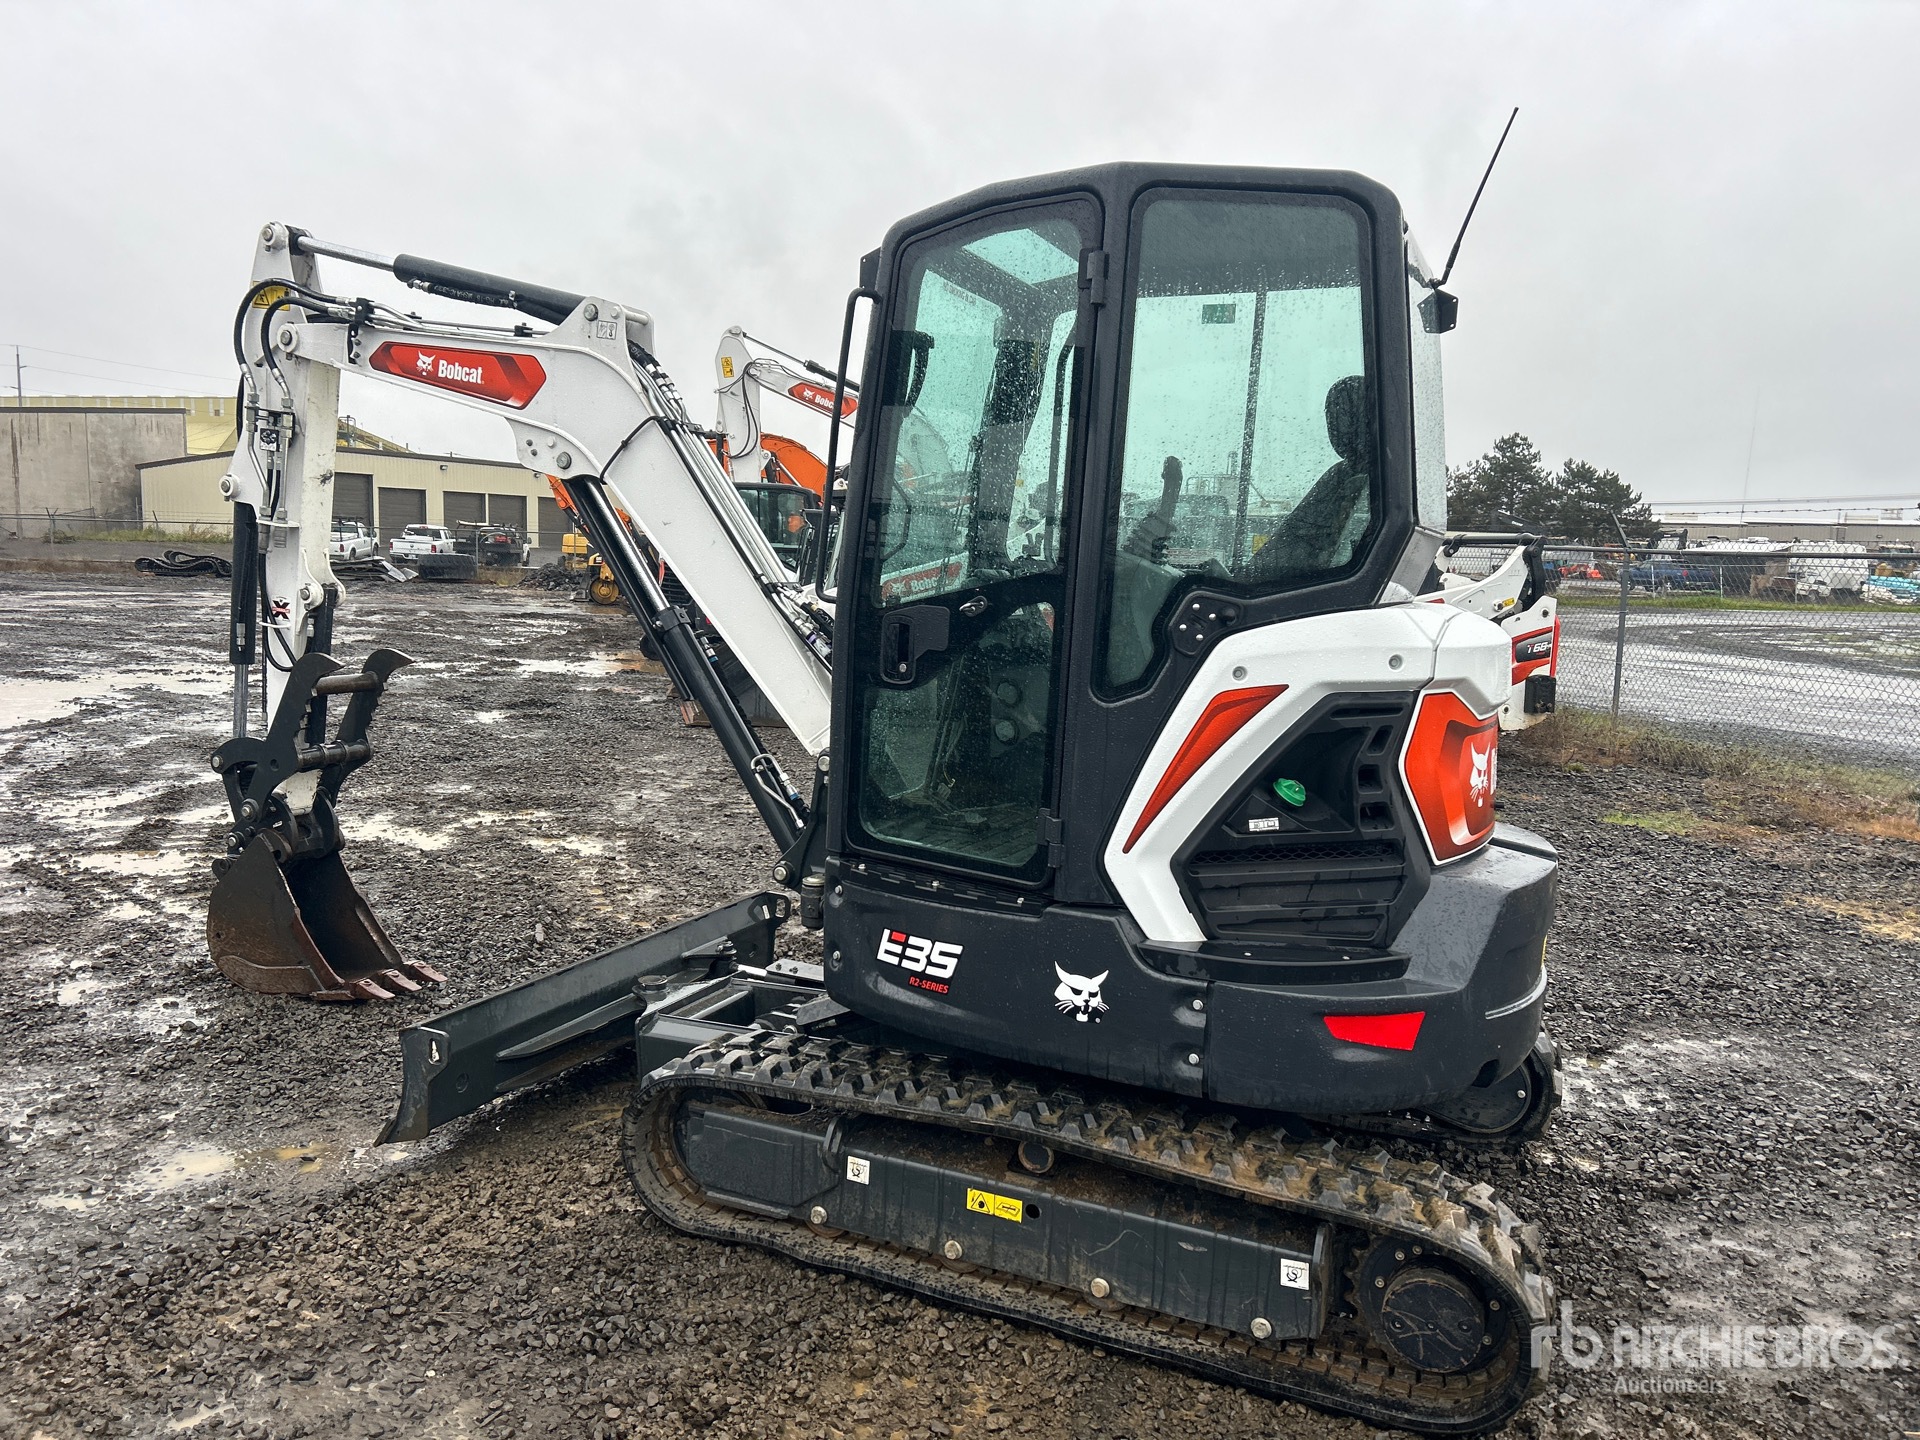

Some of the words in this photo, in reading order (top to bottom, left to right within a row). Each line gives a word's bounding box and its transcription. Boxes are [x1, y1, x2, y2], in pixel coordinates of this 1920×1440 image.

[437, 359, 483, 384] Bobcat
[815, 394, 834, 410] Bobc
[876, 928, 963, 979] E35
[908, 976, 949, 995] R2-SERIES
